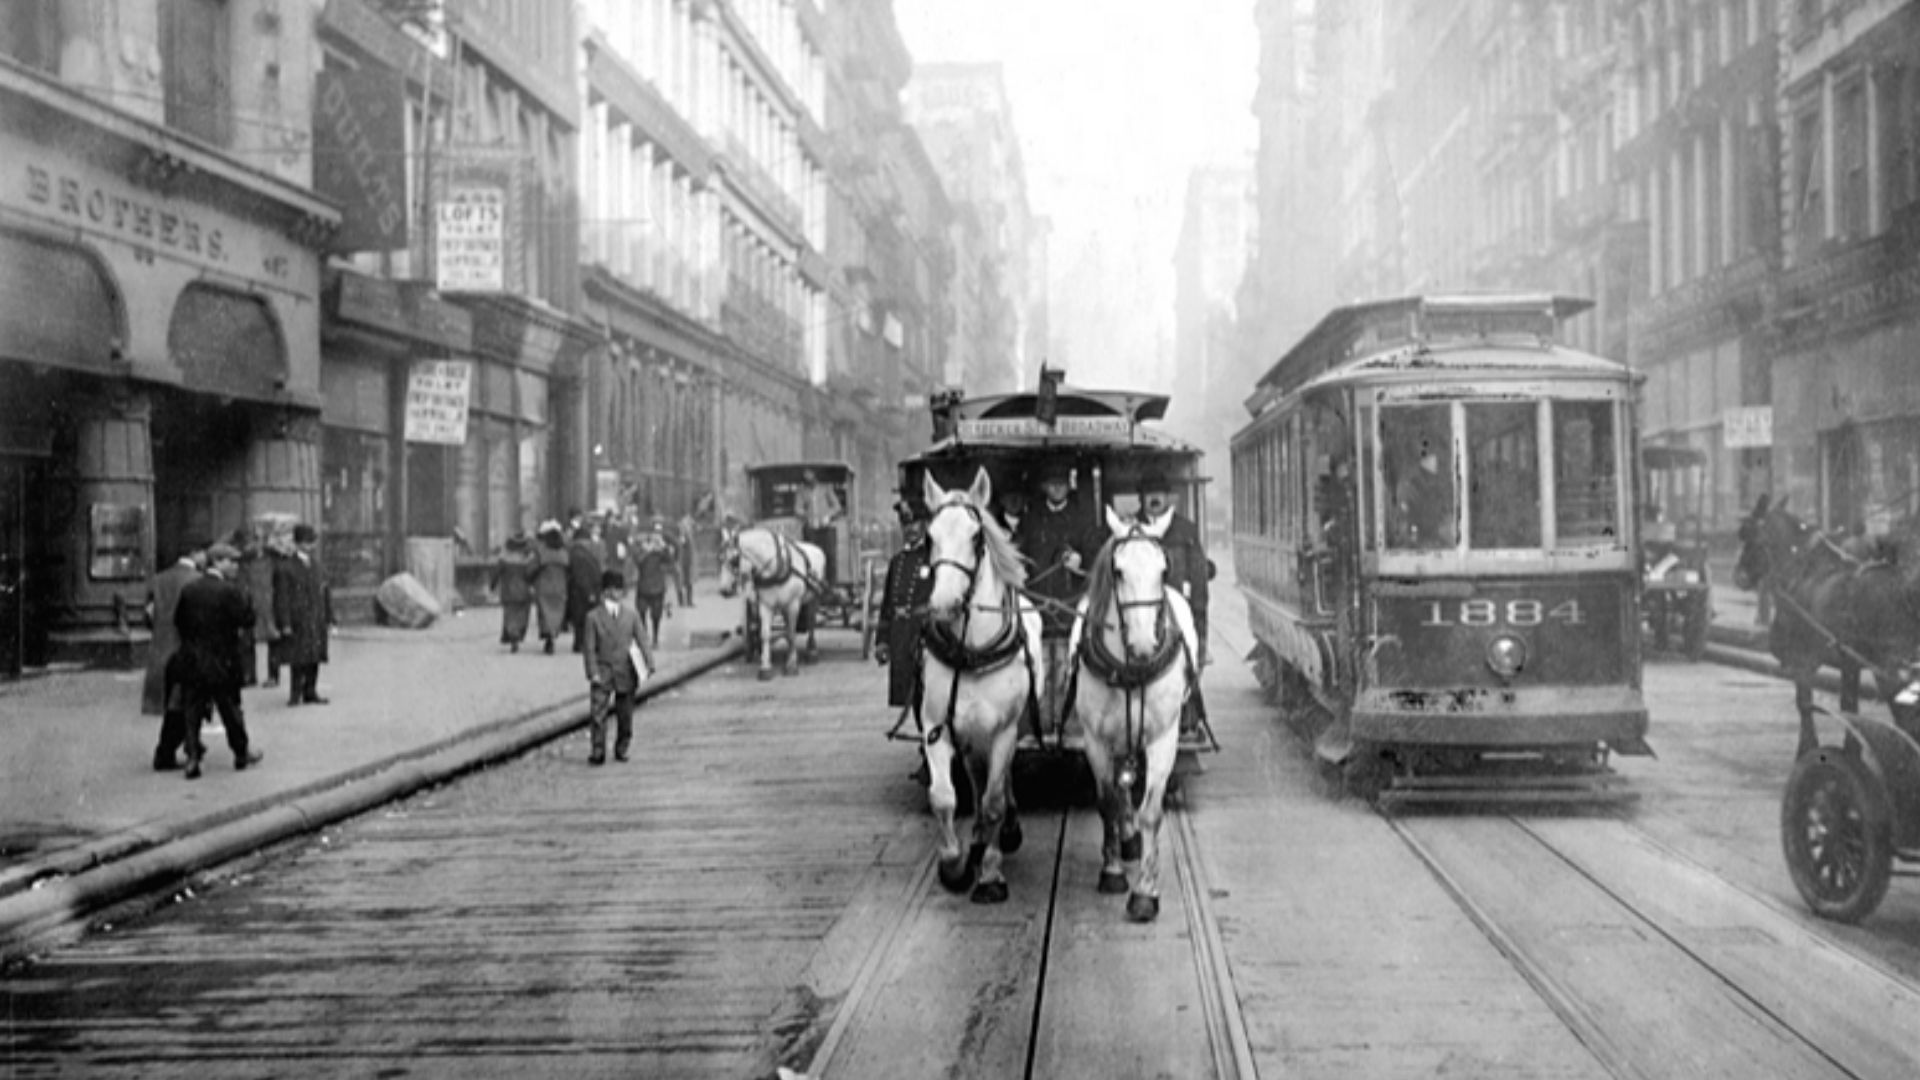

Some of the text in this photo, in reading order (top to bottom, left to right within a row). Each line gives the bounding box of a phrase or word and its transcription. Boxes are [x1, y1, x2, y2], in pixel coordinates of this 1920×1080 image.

[27, 164, 229, 261] BROTHERS.
[440, 204, 499, 221] LOFTS
[1420, 600, 1586, 627] 1884
